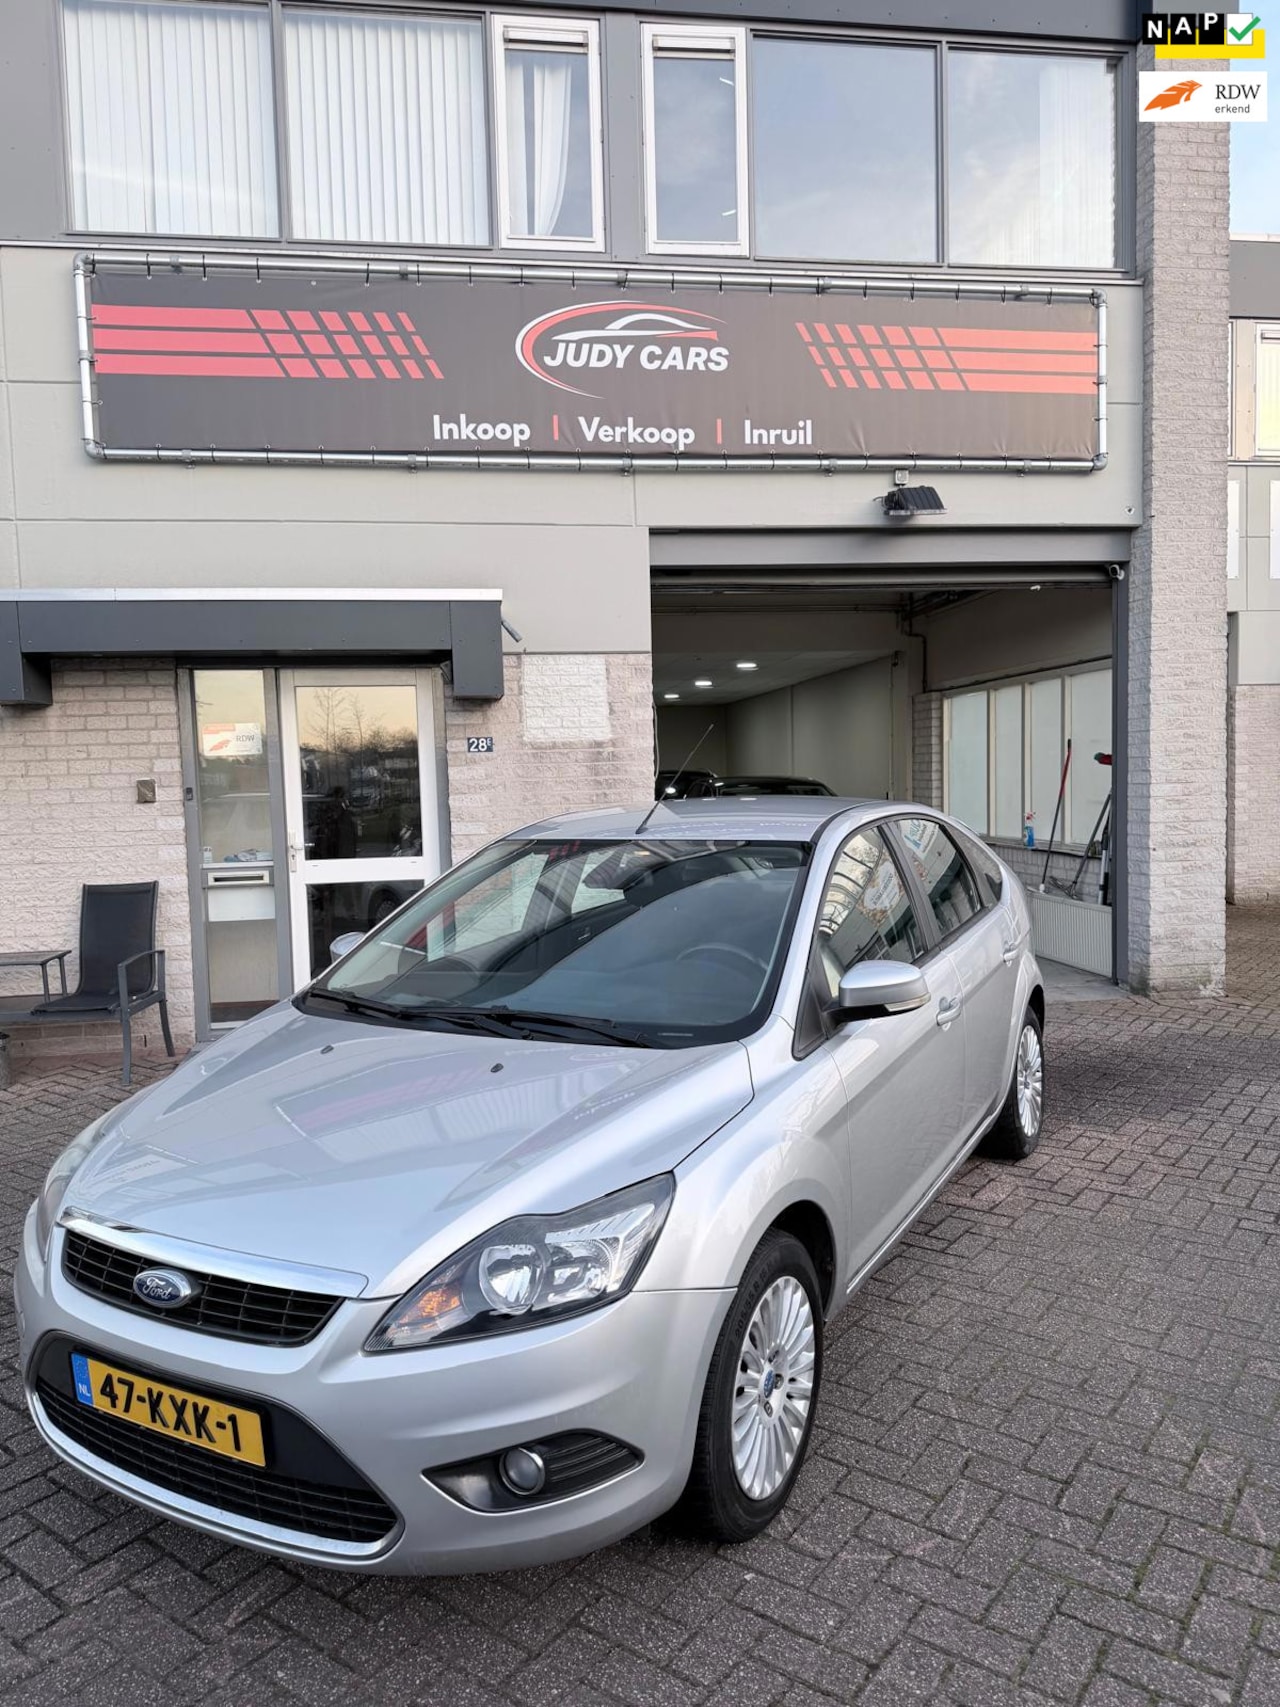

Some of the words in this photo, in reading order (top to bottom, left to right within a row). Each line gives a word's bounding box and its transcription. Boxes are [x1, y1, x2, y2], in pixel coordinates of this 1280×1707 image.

[543, 342, 635, 369] JUDY
[639, 346, 730, 372] CARS
[433, 413, 531, 447] Inkoop
[577, 416, 696, 451] Verkoop
[744, 419, 813, 445] Inruil
[236, 734, 255, 742] RDW
[142, 1276, 173, 1300] Ford
[78, 1382, 91, 1397] NL
[100, 1373, 242, 1452] 47-KXK-1
